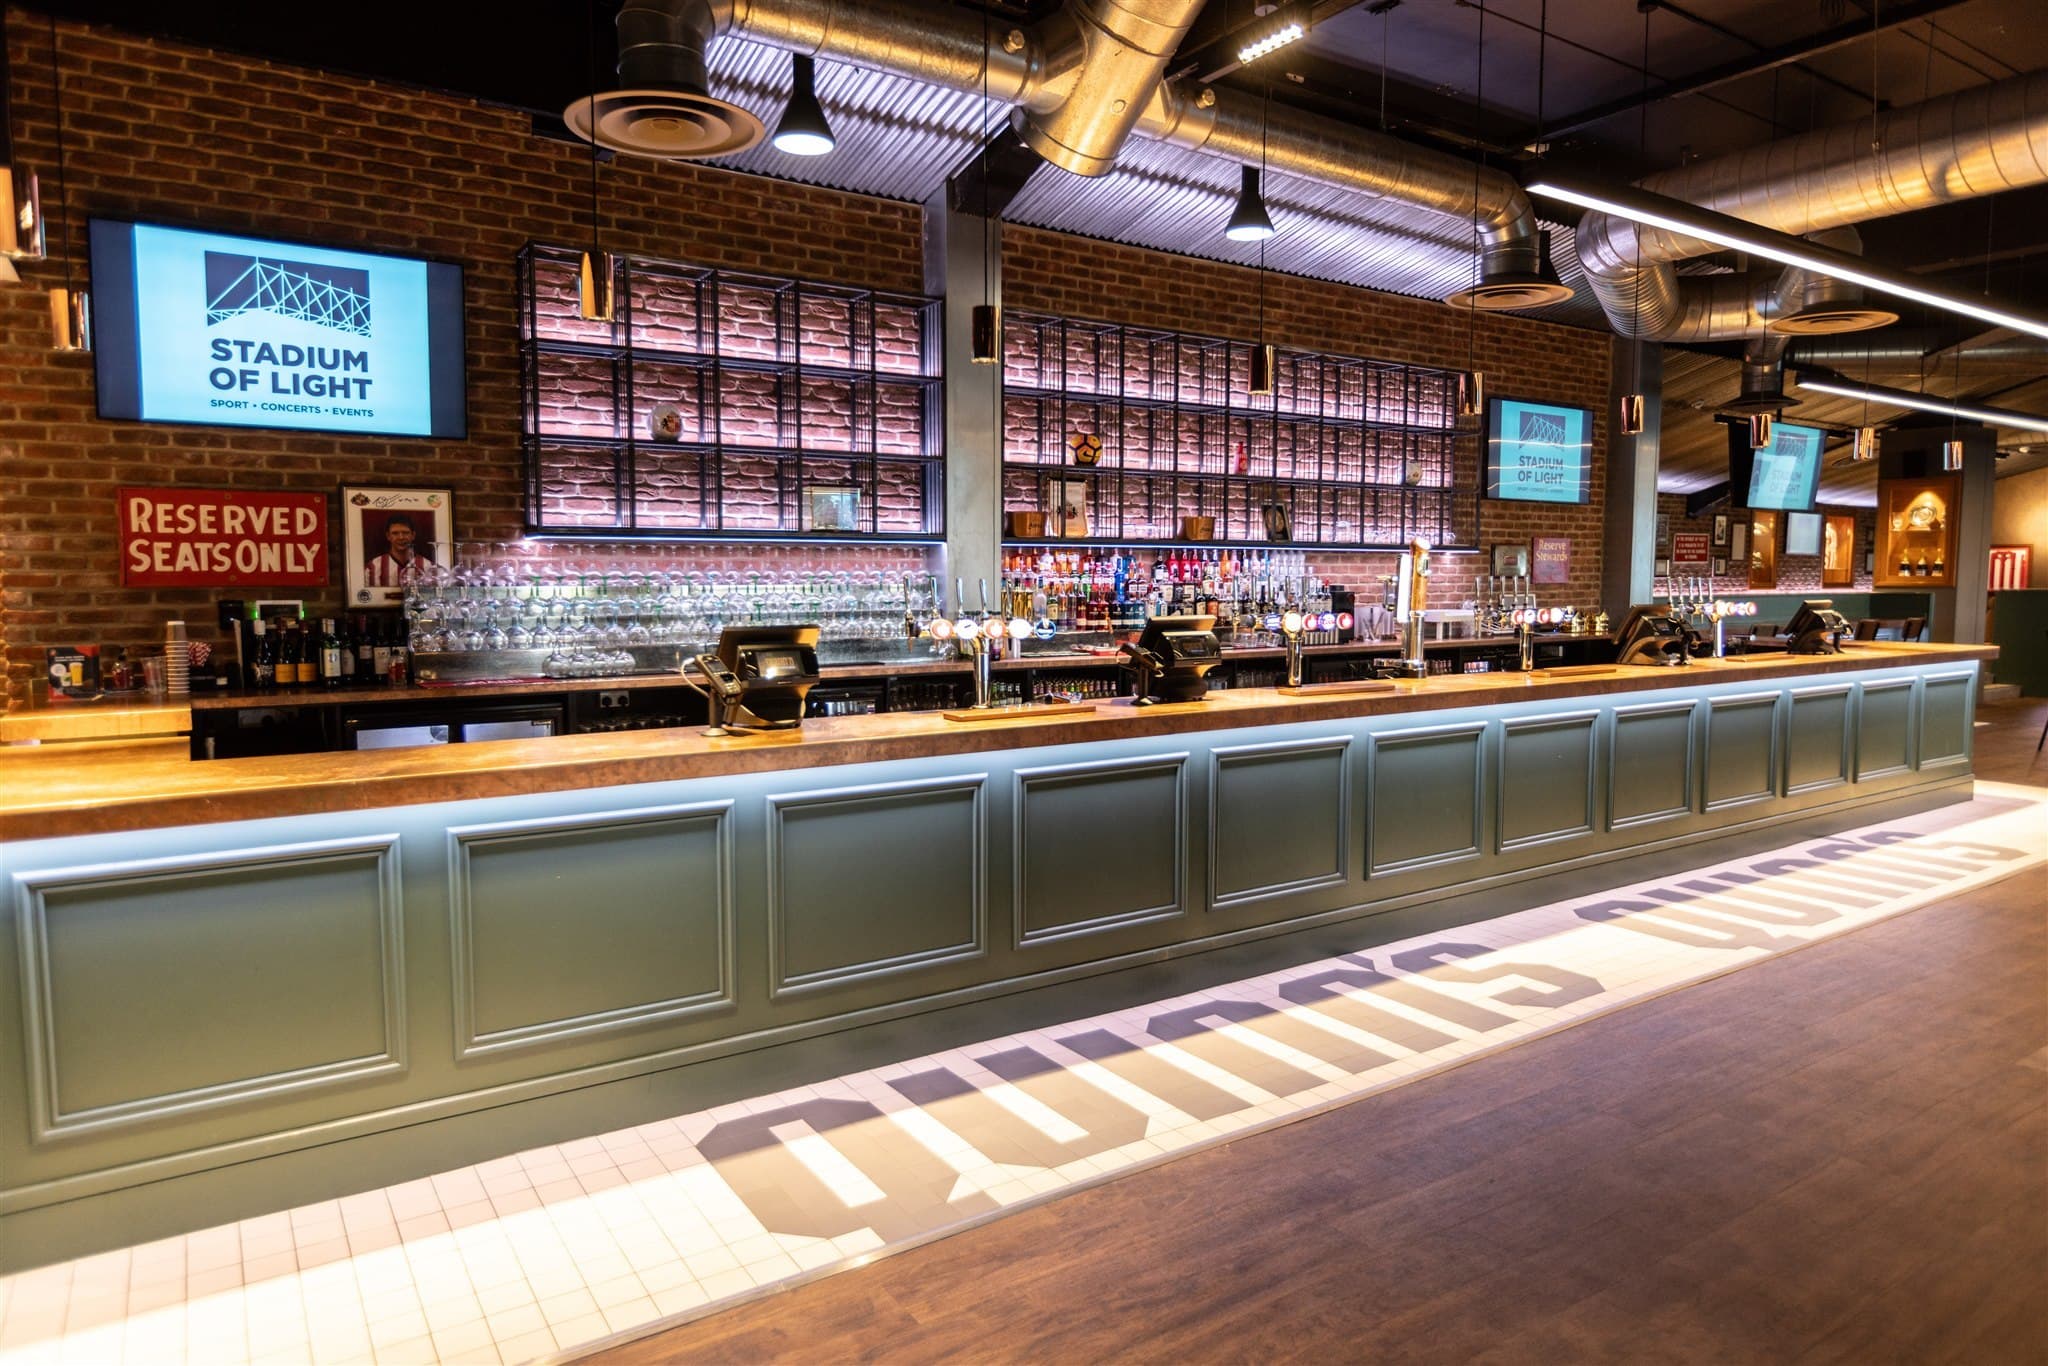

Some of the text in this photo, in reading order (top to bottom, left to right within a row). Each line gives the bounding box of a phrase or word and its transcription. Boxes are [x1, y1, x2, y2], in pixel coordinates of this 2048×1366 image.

[211, 338, 368, 373] STADIUM
[209, 367, 373, 400] OF LIGHT
[211, 399, 374, 417] SPORT CONCERTS EVENTS
[1519, 455, 1563, 470] STADIUM
[1518, 470, 1564, 484] OF LIGHT
[129, 497, 318, 536] RESERVED
[1538, 539, 1567, 551] Reserve
